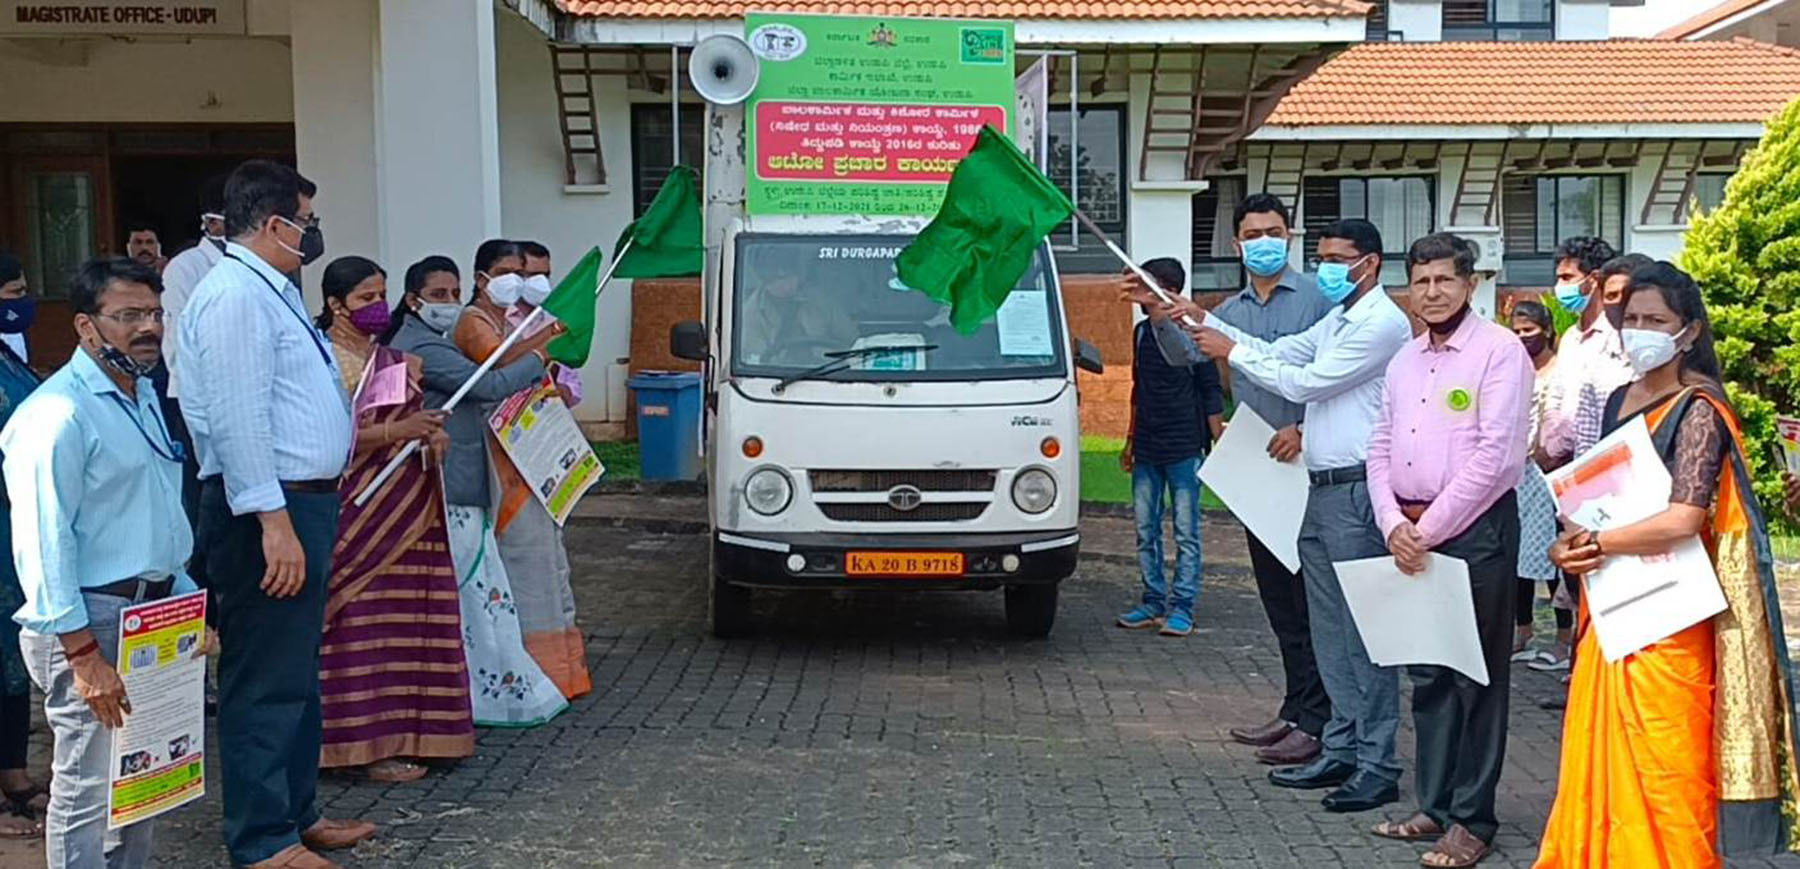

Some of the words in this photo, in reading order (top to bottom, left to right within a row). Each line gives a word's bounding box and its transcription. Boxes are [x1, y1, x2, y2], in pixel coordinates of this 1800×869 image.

[16, 6, 110, 23] MAGISTRATE
[113, 6, 164, 23] OFFICE
[174, 7, 217, 23] UDUPI
[781, 105, 852, 115] ಬಾಲಕಾರ್ಮಿಕ
[856, 106, 885, 120] ಮತ್ತು
[935, 108, 979, 118] ಕಾರ್ಮಿಕ
[815, 121, 844, 135] ಮತ್ತು
[800, 137, 844, 152] ತಿದ್ದುಪಡಿ
[886, 139, 922, 150] 2016ರ
[927, 140, 962, 151] ಕುರಿತು
[768, 153, 824, 170] ಆಟೋ
[833, 154, 887, 176] ಪ್ರಚಾರ
[816, 201, 870, 211] 17-12-2021
[818, 247, 838, 259] SRI
[852, 556, 876, 571] KA
[881, 559, 900, 571] 20
[906, 559, 917, 571] B
[923, 557, 959, 571] 9718
